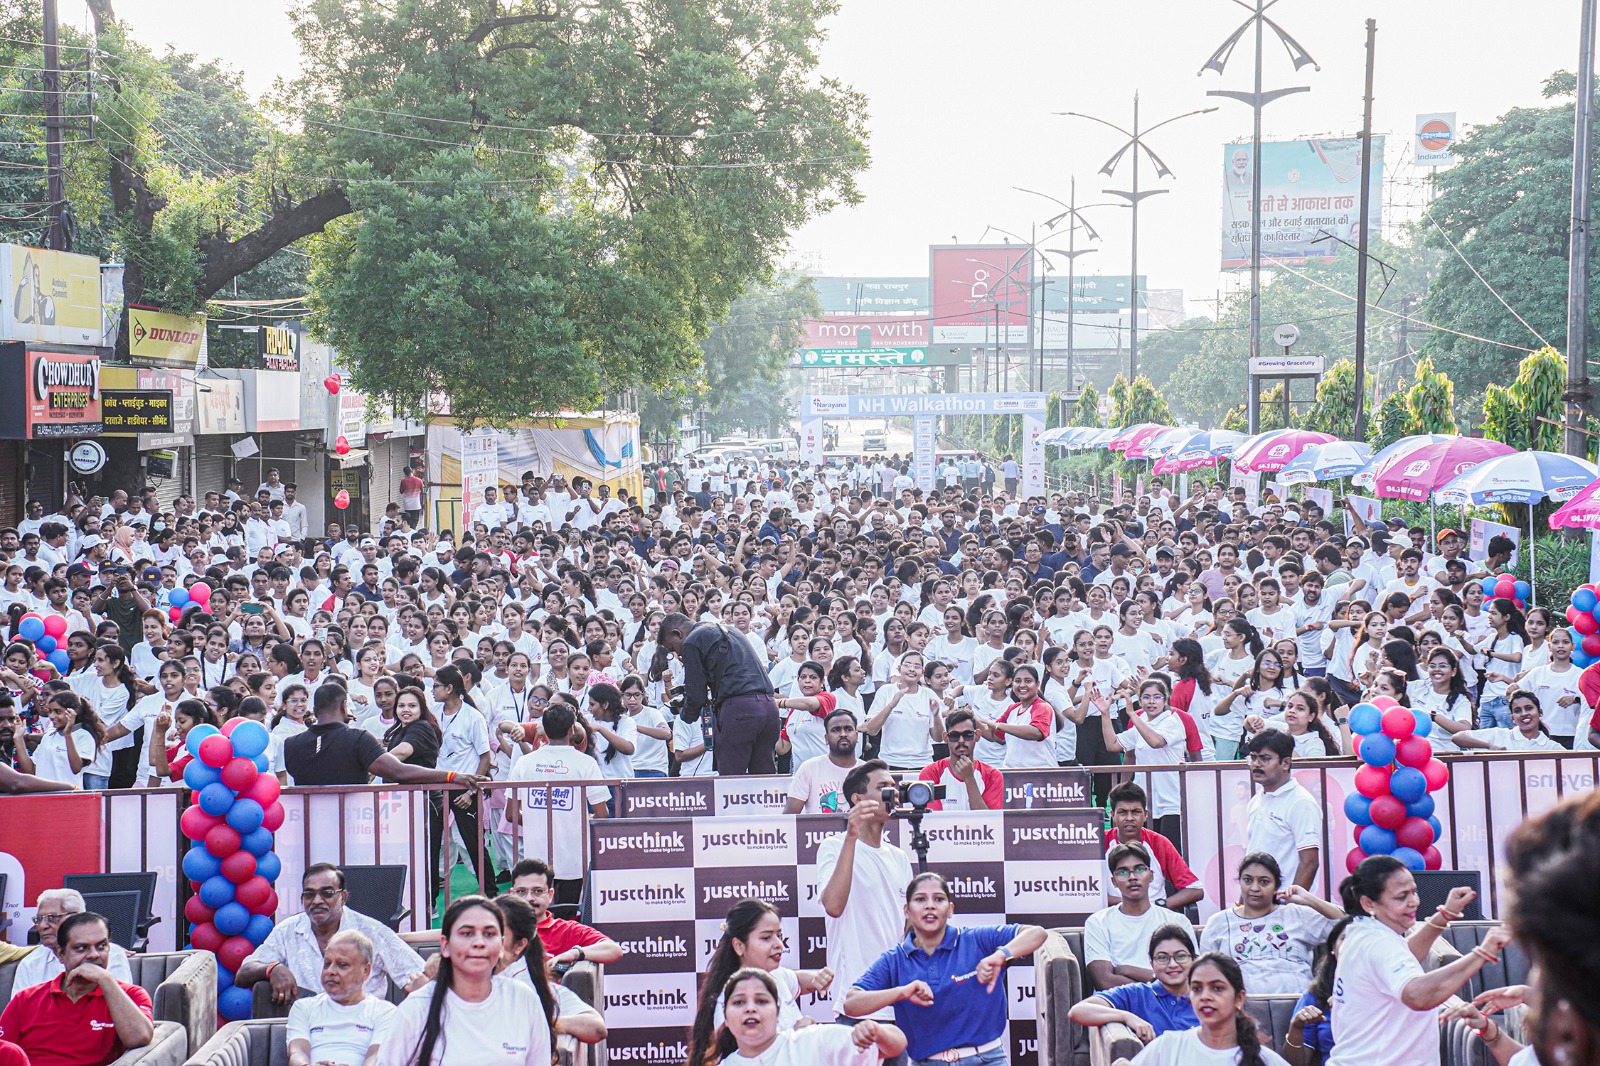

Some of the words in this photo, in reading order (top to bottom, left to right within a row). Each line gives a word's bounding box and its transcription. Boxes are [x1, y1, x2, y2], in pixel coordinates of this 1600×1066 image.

[1276, 195, 1289, 212] से
[1291, 197, 1332, 210] आकाश
[1334, 196, 1354, 210] तक
[1338, 214, 1348, 225] की
[149, 328, 199, 344] DUNLOP
[878, 321, 923, 337] with
[820, 348, 907, 366] नमस्ते
[36, 356, 101, 400] CHOWDHURY
[54, 392, 88, 408] ENTERPRISES
[858, 398, 884, 413] NH
[891, 397, 986, 412] Walkathon
[1411, 488, 1422, 496] FM
[723, 790, 788, 809] justthin
[1006, 782, 1084, 802] jutthink
[909, 825, 994, 841] stthink
[947, 877, 996, 893] think
[615, 935, 687, 954] stthink
[607, 1041, 688, 1060] ustthink
